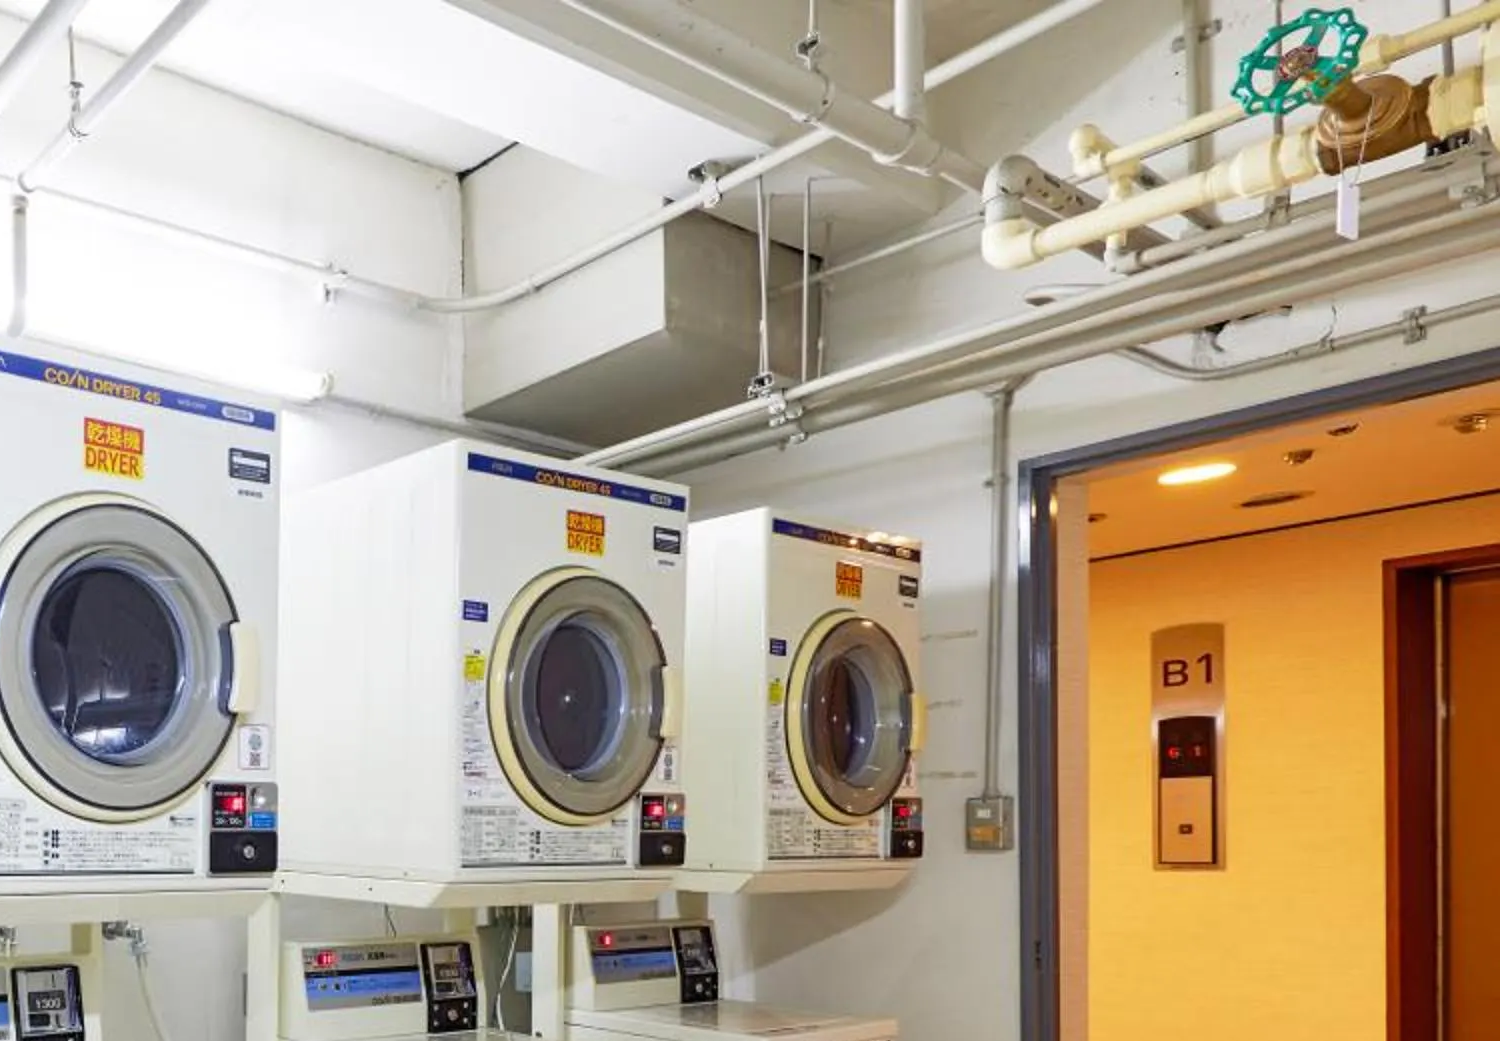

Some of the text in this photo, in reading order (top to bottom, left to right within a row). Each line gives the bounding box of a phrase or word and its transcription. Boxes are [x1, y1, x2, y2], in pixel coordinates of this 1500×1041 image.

[92, 378, 141, 401] DRYER
[143, 390, 162, 404] 45
[85, 446, 140, 477] DRYER
[1162, 652, 1214, 687] B1
